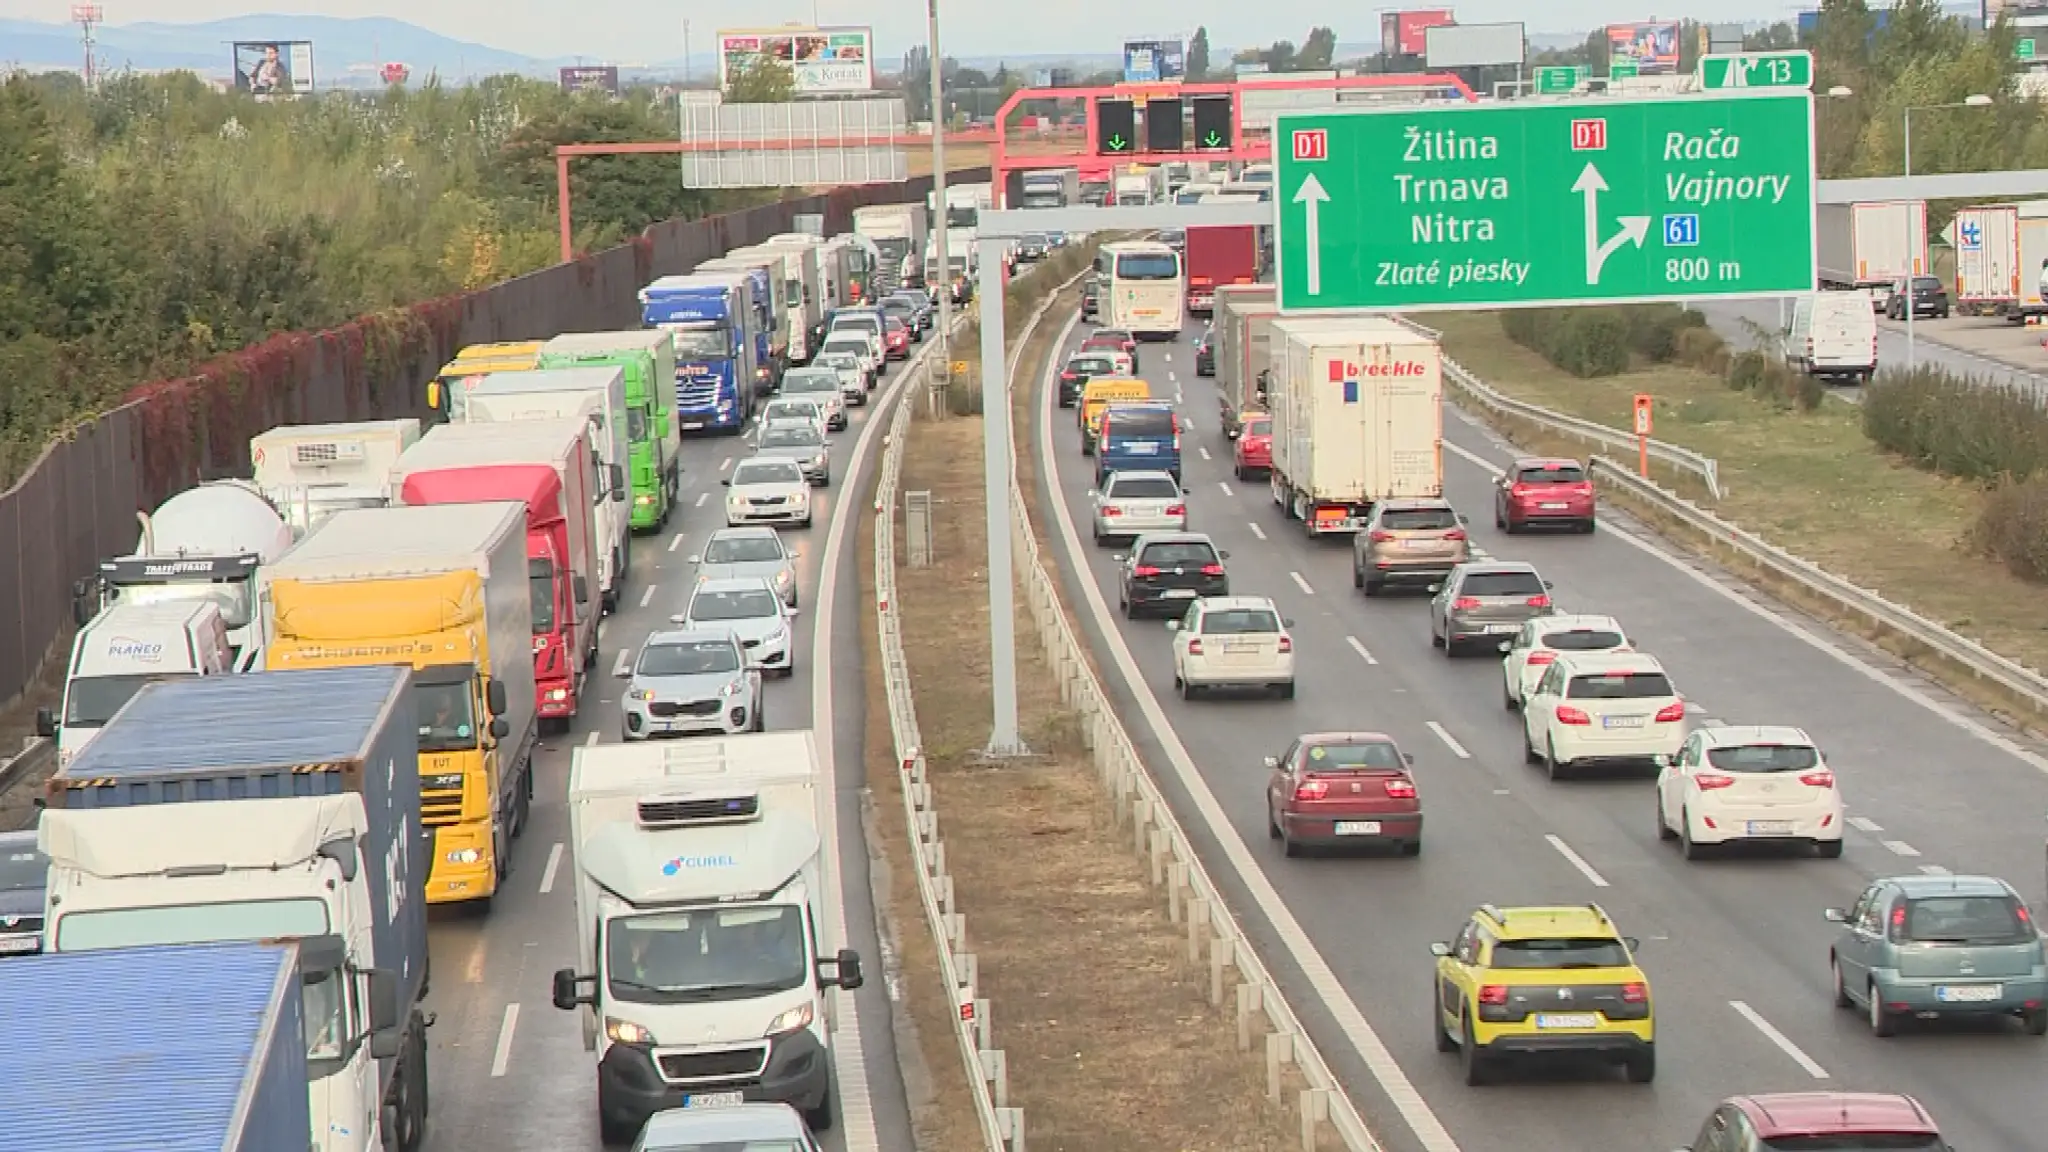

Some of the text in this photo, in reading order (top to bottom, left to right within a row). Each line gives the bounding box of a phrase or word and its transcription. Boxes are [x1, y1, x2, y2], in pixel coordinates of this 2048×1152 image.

[1766, 59, 1792, 84] 13
[1298, 133, 1325, 158] D1
[1402, 125, 1499, 162] Žilina
[1577, 122, 1601, 148] D1
[1663, 127, 1740, 161] Rača
[1392, 173, 1510, 204] Trnava
[1665, 169, 1791, 207] Vajnory
[1411, 211, 1496, 244] Nitra
[1669, 217, 1694, 242] 61
[1374, 258, 1532, 289] Zlaté piesky
[1665, 257, 1741, 283] 800 m
[1346, 360, 1426, 377] breckle
[108, 643, 162, 657] PLANEO
